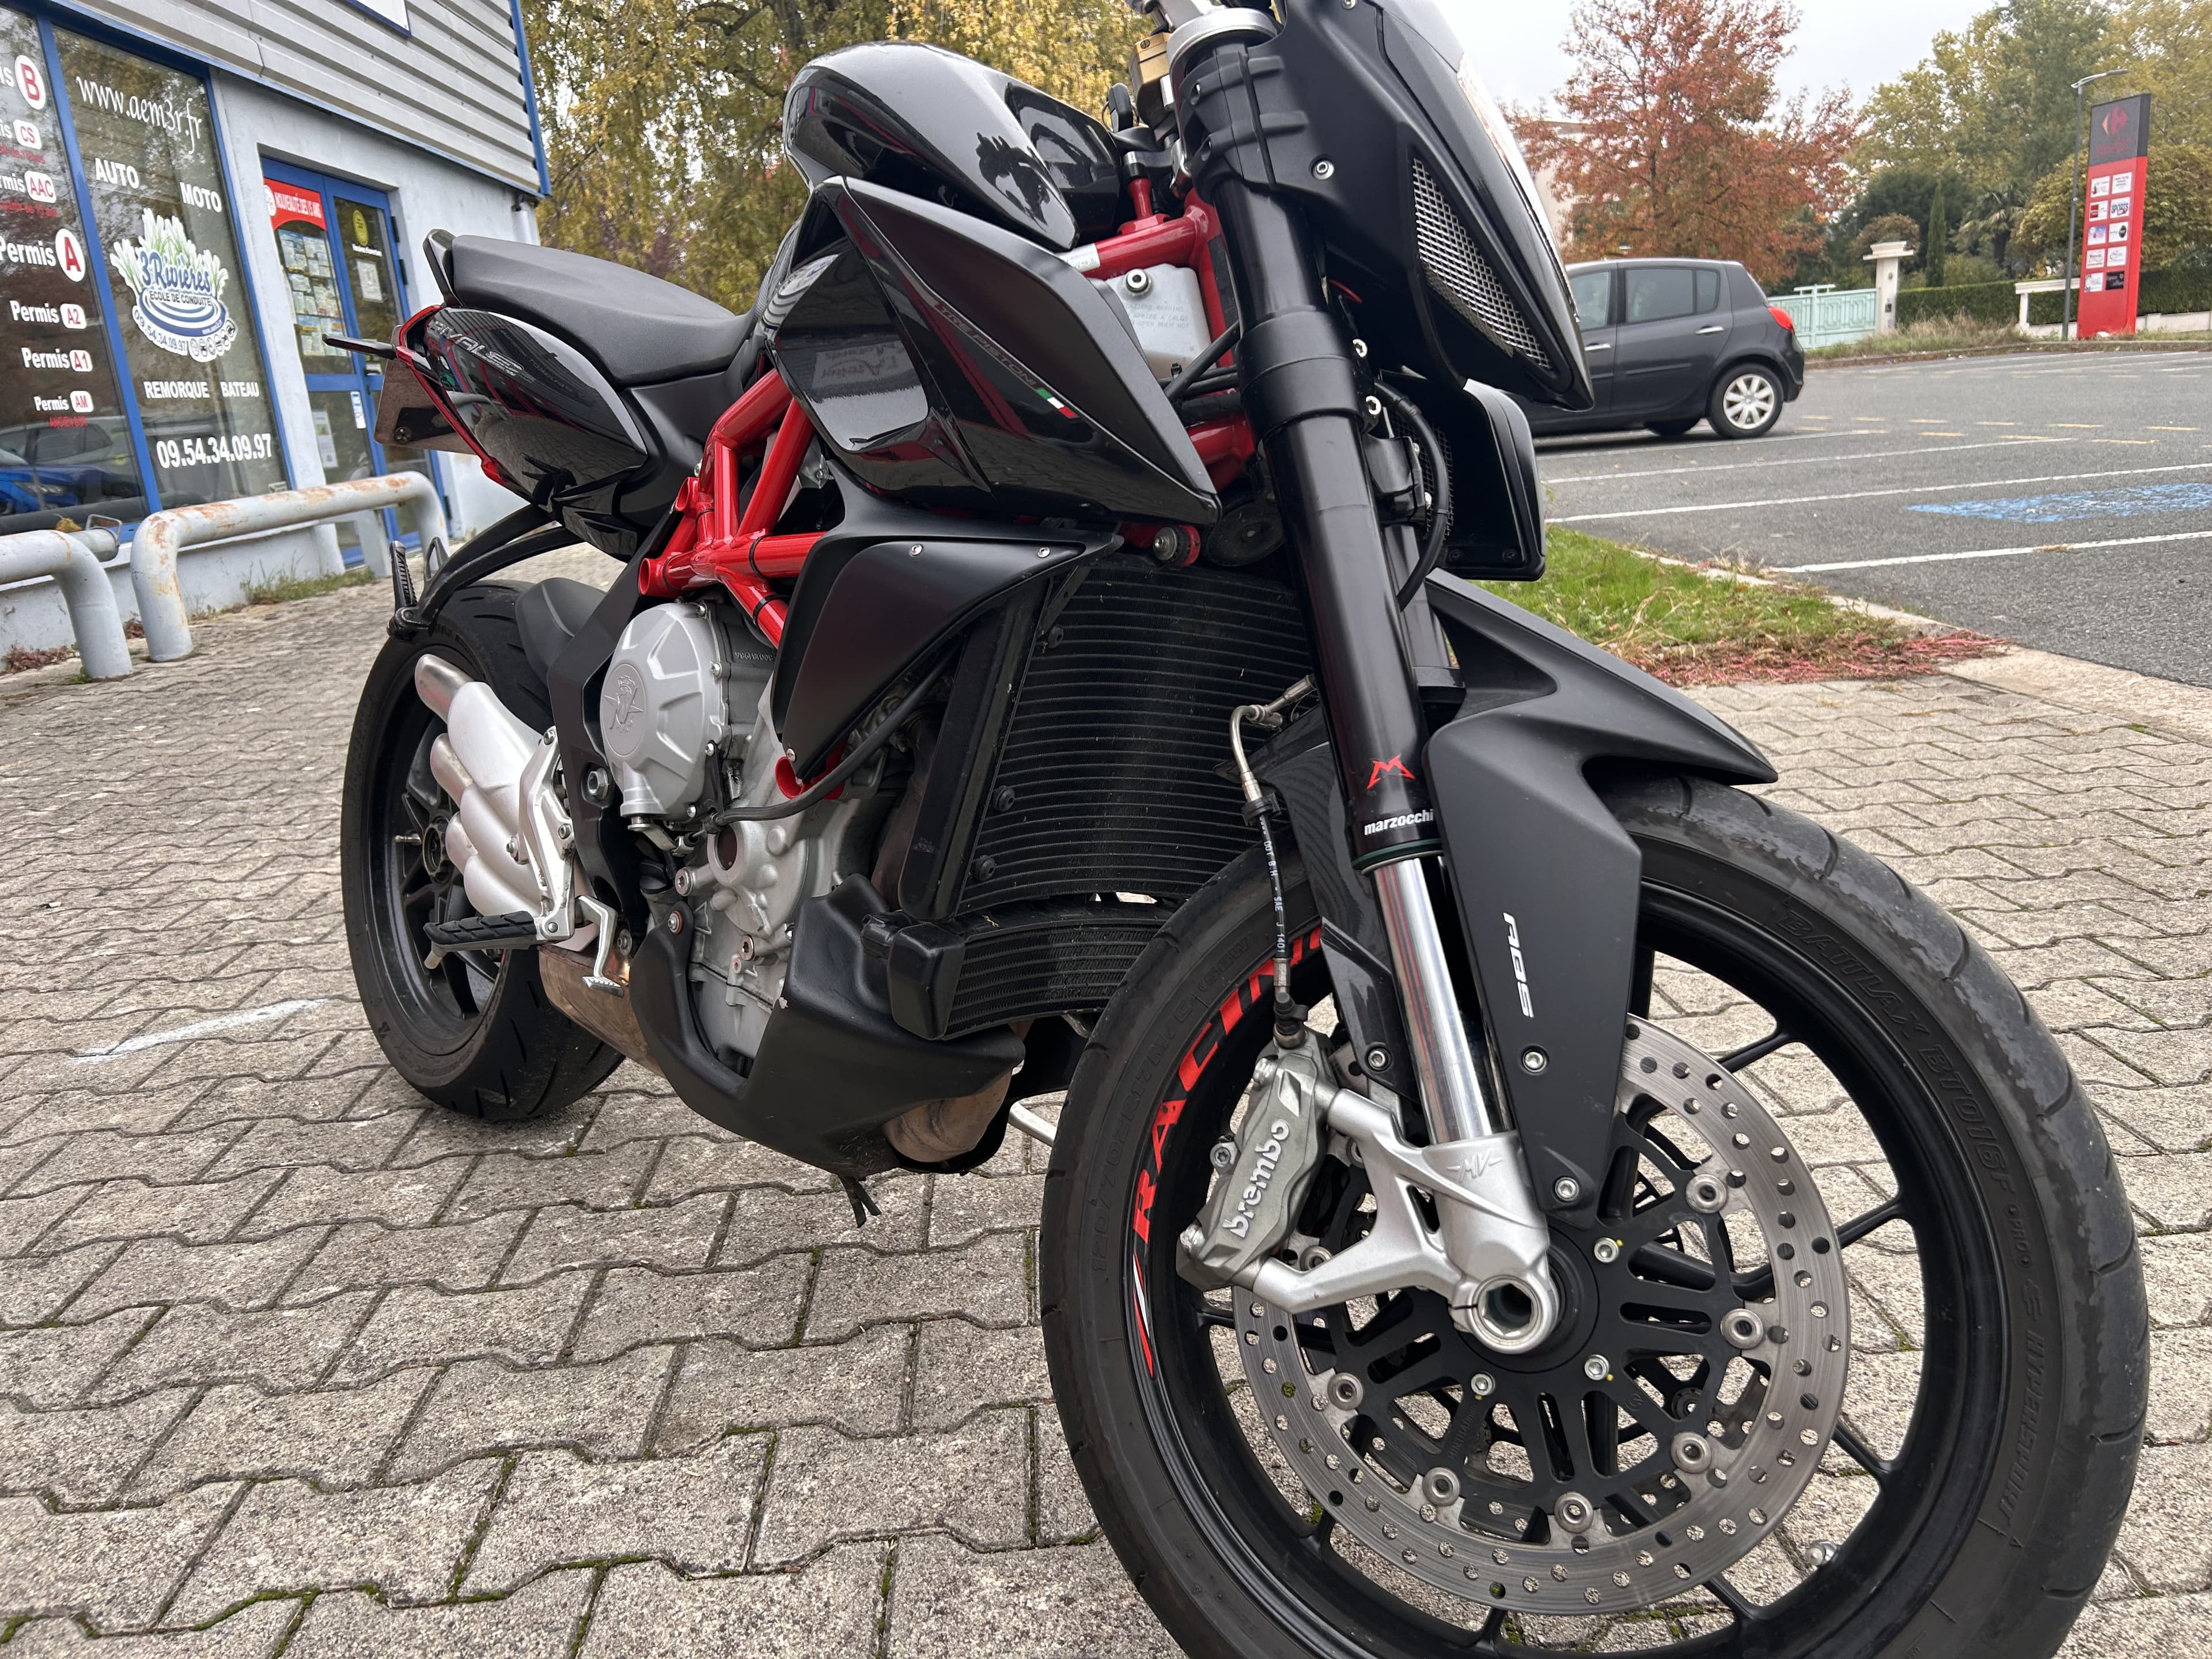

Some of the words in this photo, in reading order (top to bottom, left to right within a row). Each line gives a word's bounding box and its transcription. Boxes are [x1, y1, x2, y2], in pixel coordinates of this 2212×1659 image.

[20, 63, 40, 101] B
[76, 76, 202, 154] www.aem3r.fr
[20, 126, 35, 143] CS
[95, 158, 139, 189] AUTO
[30, 177, 54, 198] AAC
[180, 182, 222, 213] MOTO
[64, 237, 81, 272] A
[150, 290, 171, 302] ECOLE
[172, 294, 180, 304] DE
[181, 295, 212, 306] CONDUITE
[10, 300, 59, 324] Permis
[67, 308, 81, 324] A2
[21, 347, 70, 369] Permis
[74, 352, 89, 369] A1
[143, 381, 210, 399] REMORQUE
[220, 381, 260, 397] BATEAU
[33, 396, 70, 411] Permis
[75, 396, 88, 408] AM
[156, 433, 272, 469] 09.54.34.09.97
[1364, 809, 1434, 835] marzocchi
[1264, 840, 1274, 855] DOT
[1274, 896, 1283, 911] SAE
[1277, 933, 1285, 953] 1401
[1132, 926, 1321, 1244] RACIN
[1222, 1119, 1290, 1238] brembo
